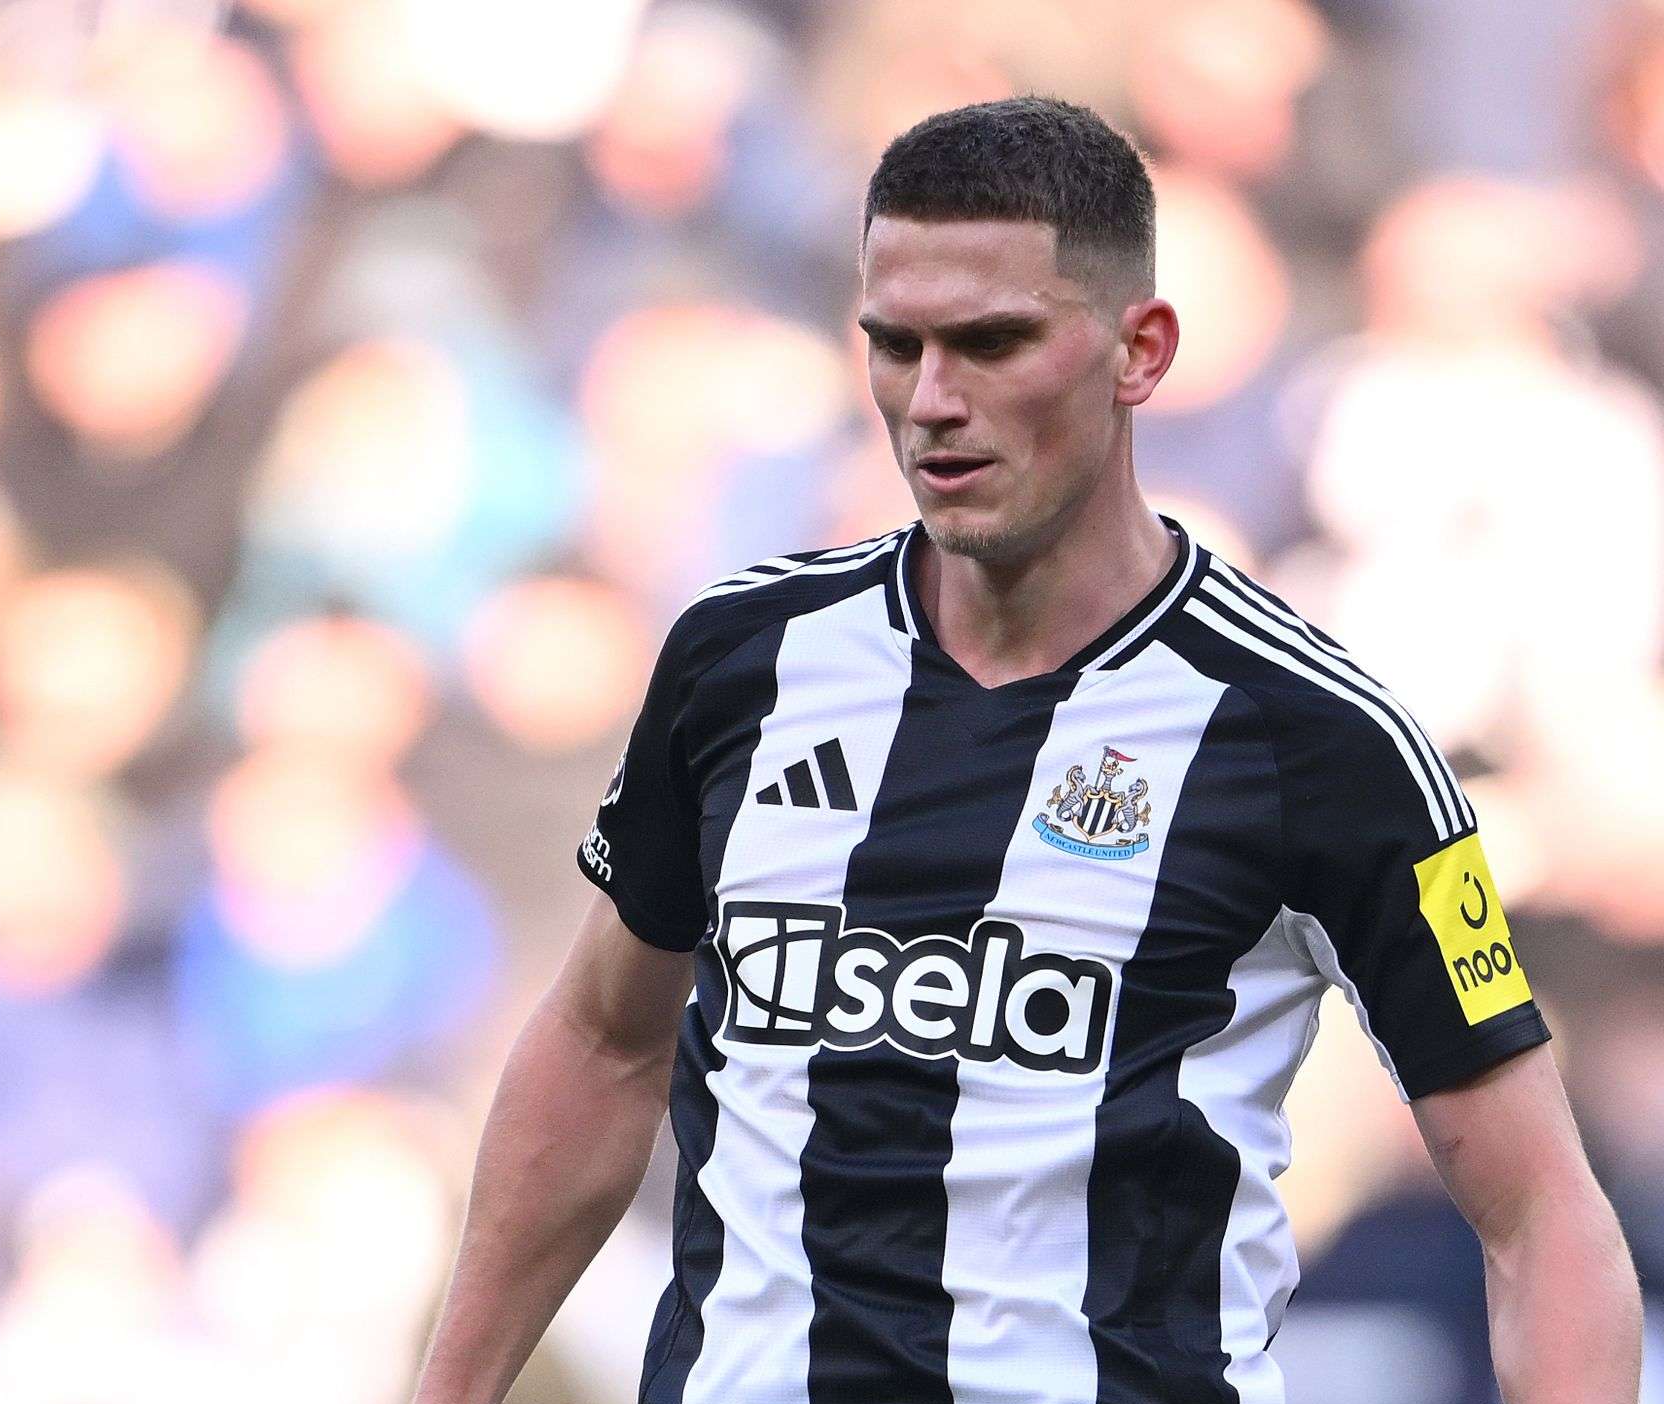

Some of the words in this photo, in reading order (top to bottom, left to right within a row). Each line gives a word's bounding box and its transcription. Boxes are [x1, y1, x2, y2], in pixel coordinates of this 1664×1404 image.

[1044, 832, 1095, 856] NEWCASTLE
[1095, 848, 1132, 858] UNITED
[1452, 937, 1522, 992] noo
[826, 936, 1097, 1060] sela
